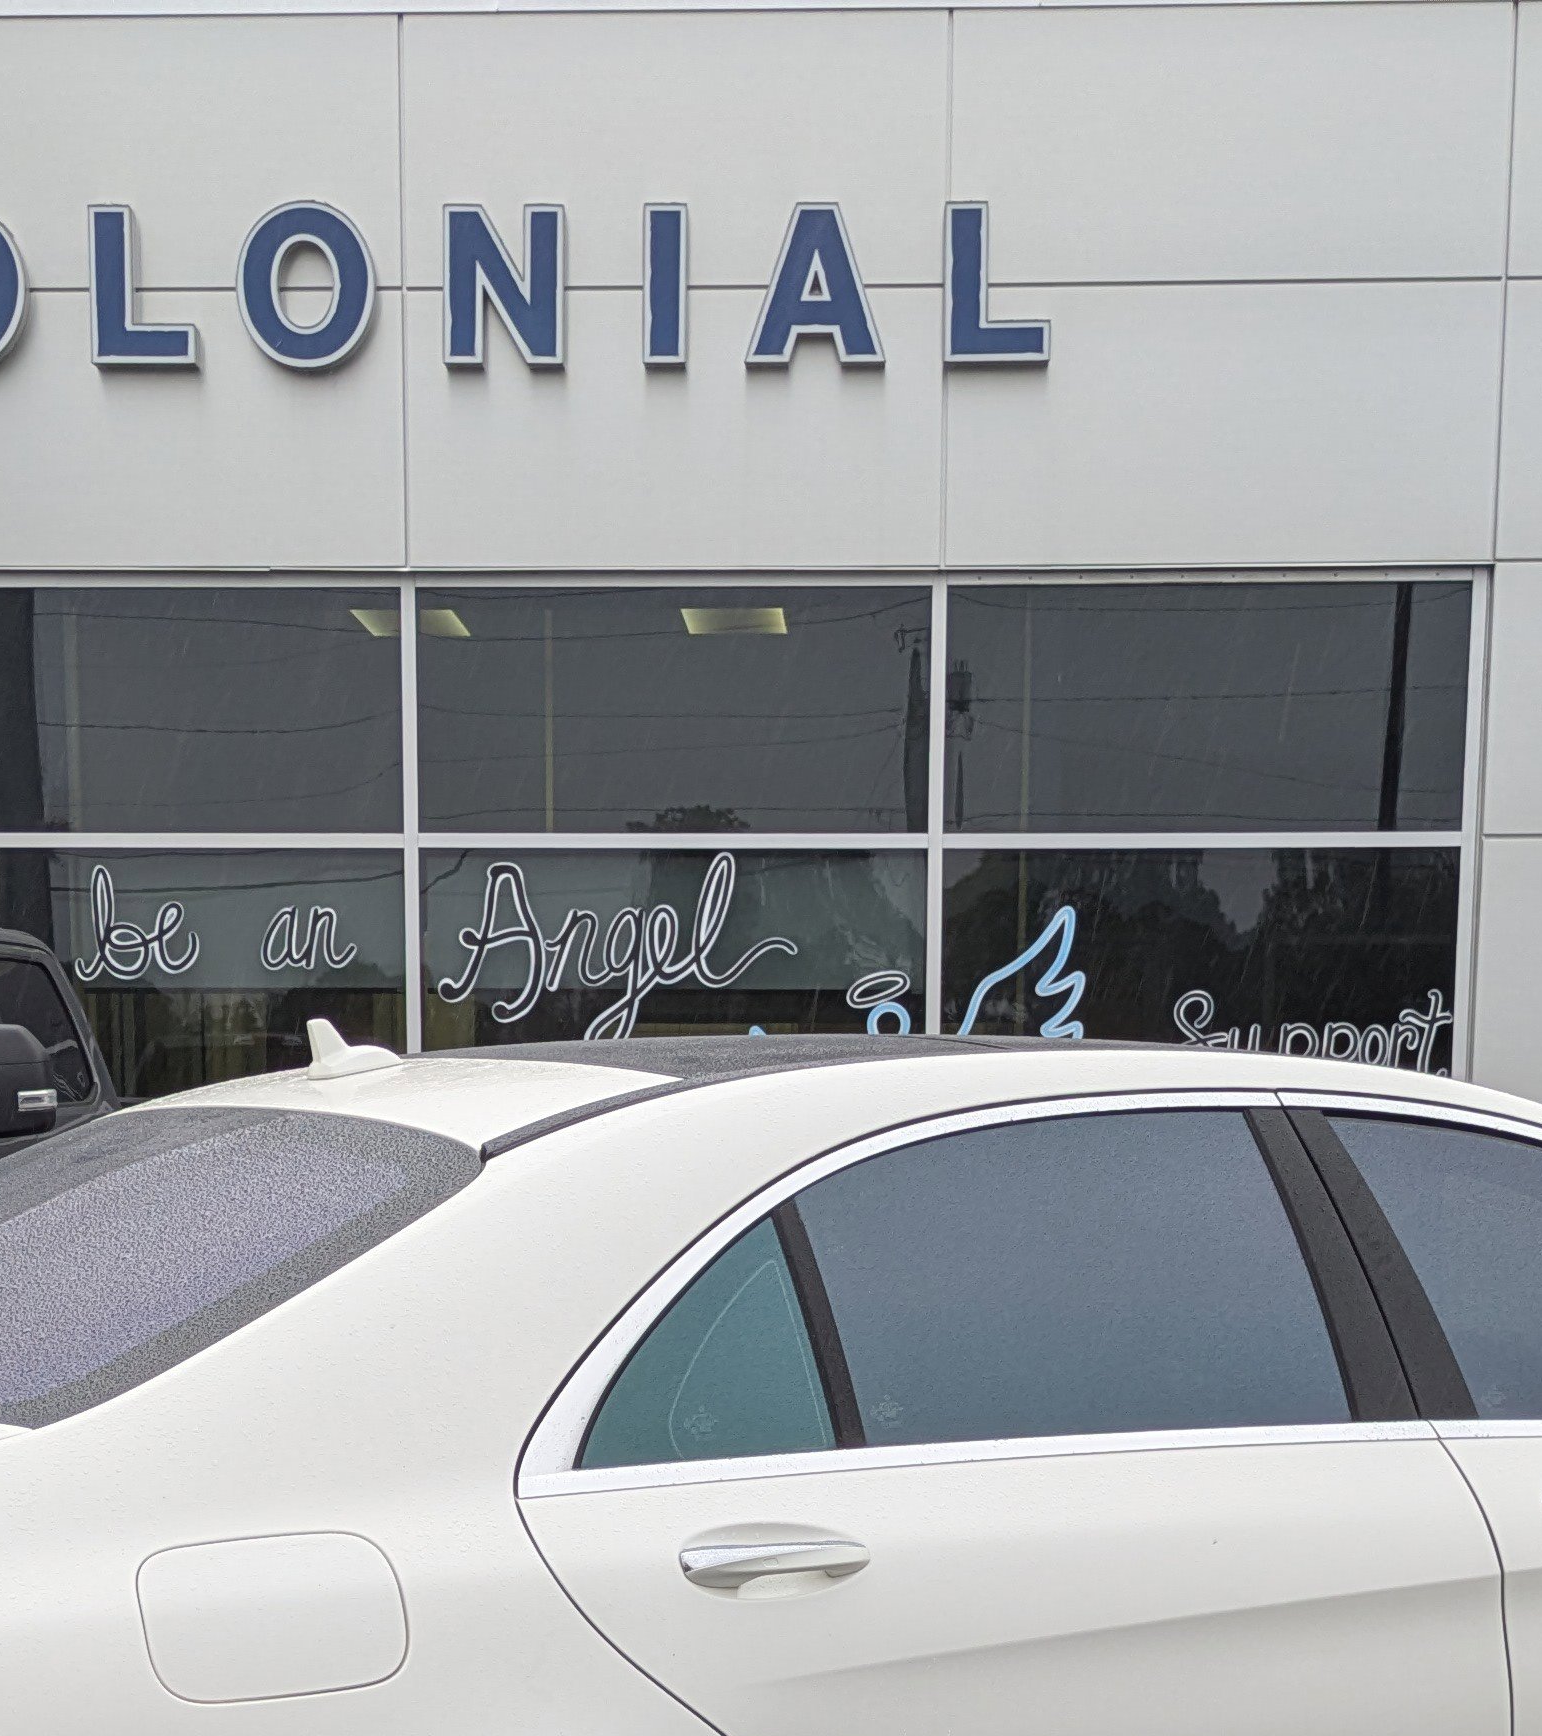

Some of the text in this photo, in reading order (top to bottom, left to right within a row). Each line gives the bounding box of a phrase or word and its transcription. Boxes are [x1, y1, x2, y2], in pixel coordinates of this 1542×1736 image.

[75, 852, 799, 1041] be an Angel
